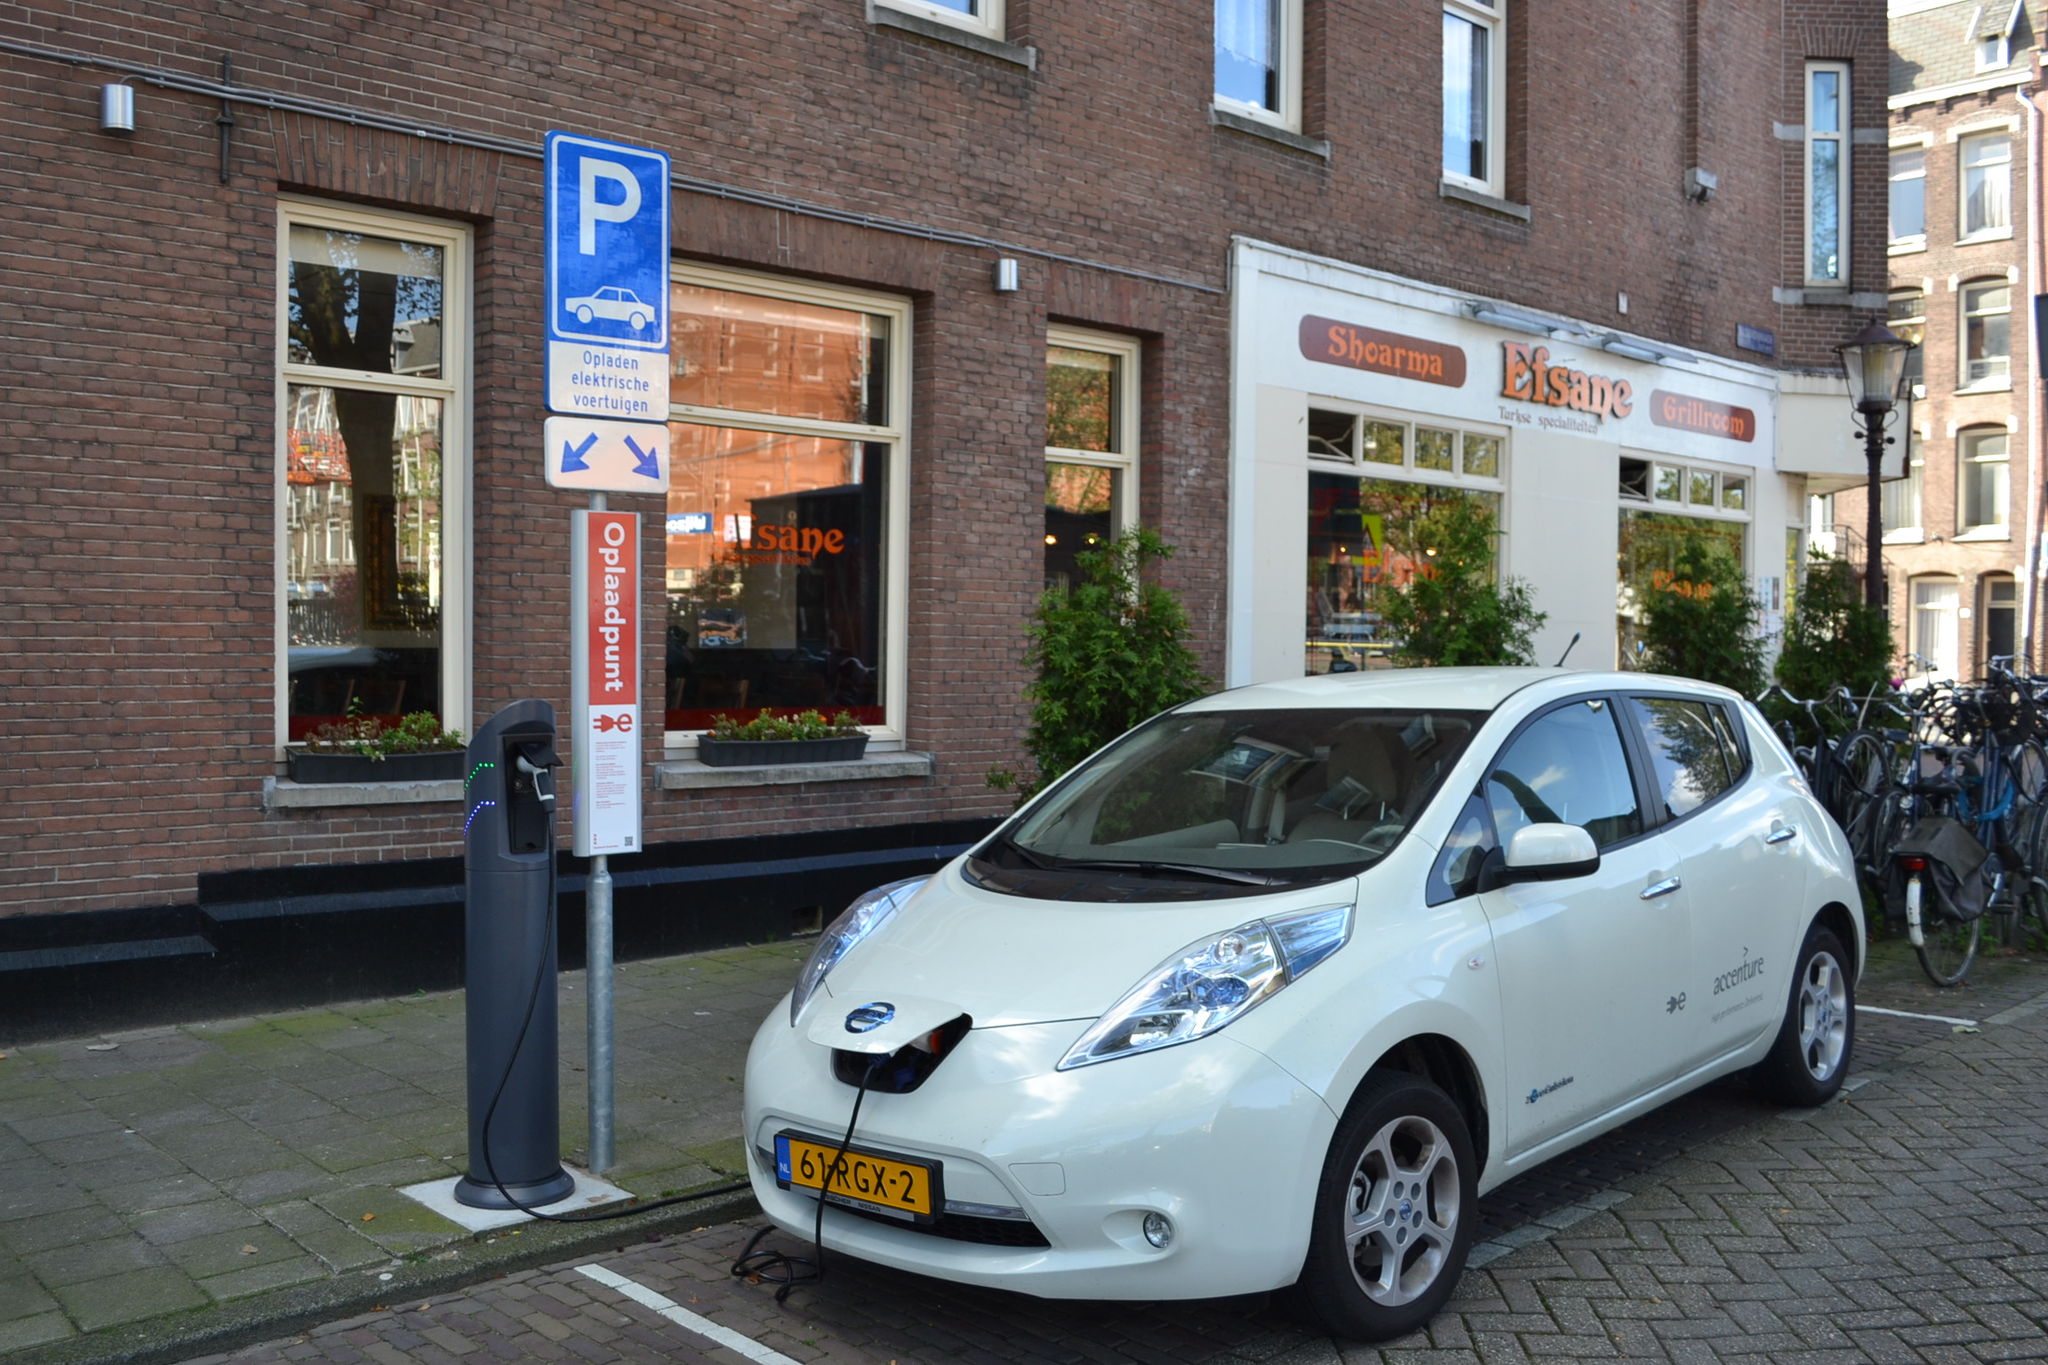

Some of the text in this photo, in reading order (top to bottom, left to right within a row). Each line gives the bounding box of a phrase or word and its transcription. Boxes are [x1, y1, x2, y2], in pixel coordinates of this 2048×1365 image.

[579, 156, 641, 255] P
[583, 350, 639, 370] Opladen
[1327, 325, 1443, 378] Shoarma
[571, 371, 649, 391] elektrische
[1500, 341, 1632, 424] Efsane
[573, 394, 648, 415] voertuigen
[1663, 396, 1745, 438] Grillroom
[598, 521, 627, 692] Oplaadpunt
[1713, 956, 1765, 996] accenture
[779, 1162, 791, 1174] NL
[801, 1149, 916, 1204] 61-RGX-2
